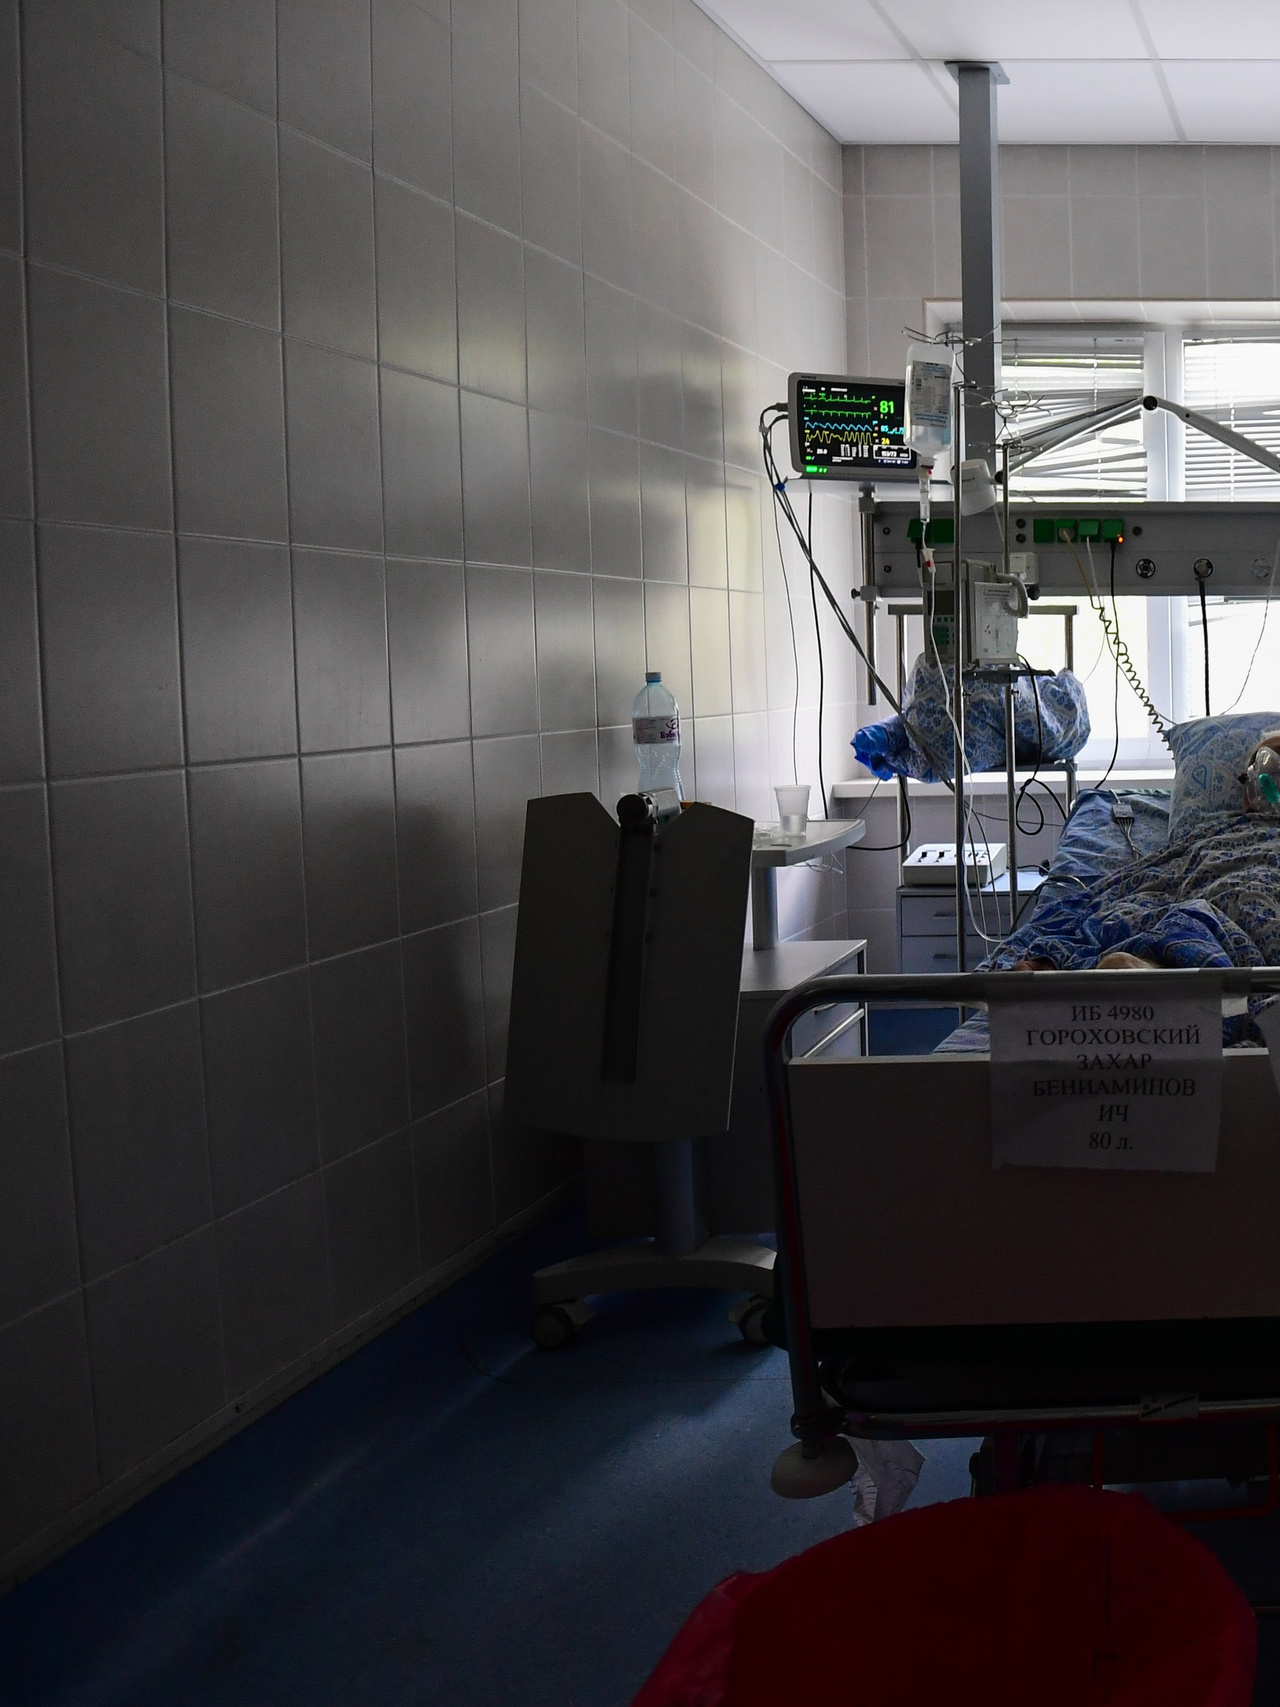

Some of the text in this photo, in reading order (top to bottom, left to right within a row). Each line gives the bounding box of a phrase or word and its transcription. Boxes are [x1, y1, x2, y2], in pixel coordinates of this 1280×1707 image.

[879, 400, 894, 414] 81
[1071, 1005, 1155, 1022] ИБ 4980
[1026, 1027, 1201, 1047] ГОРОХОВСКИЙ
[1079, 1053, 1152, 1071] ЗАХАР
[1033, 1077, 1196, 1097] БЕНИАМИНОВ
[1098, 1104, 1129, 1123] ИЧ
[1088, 1131, 1134, 1151] 80 л.
